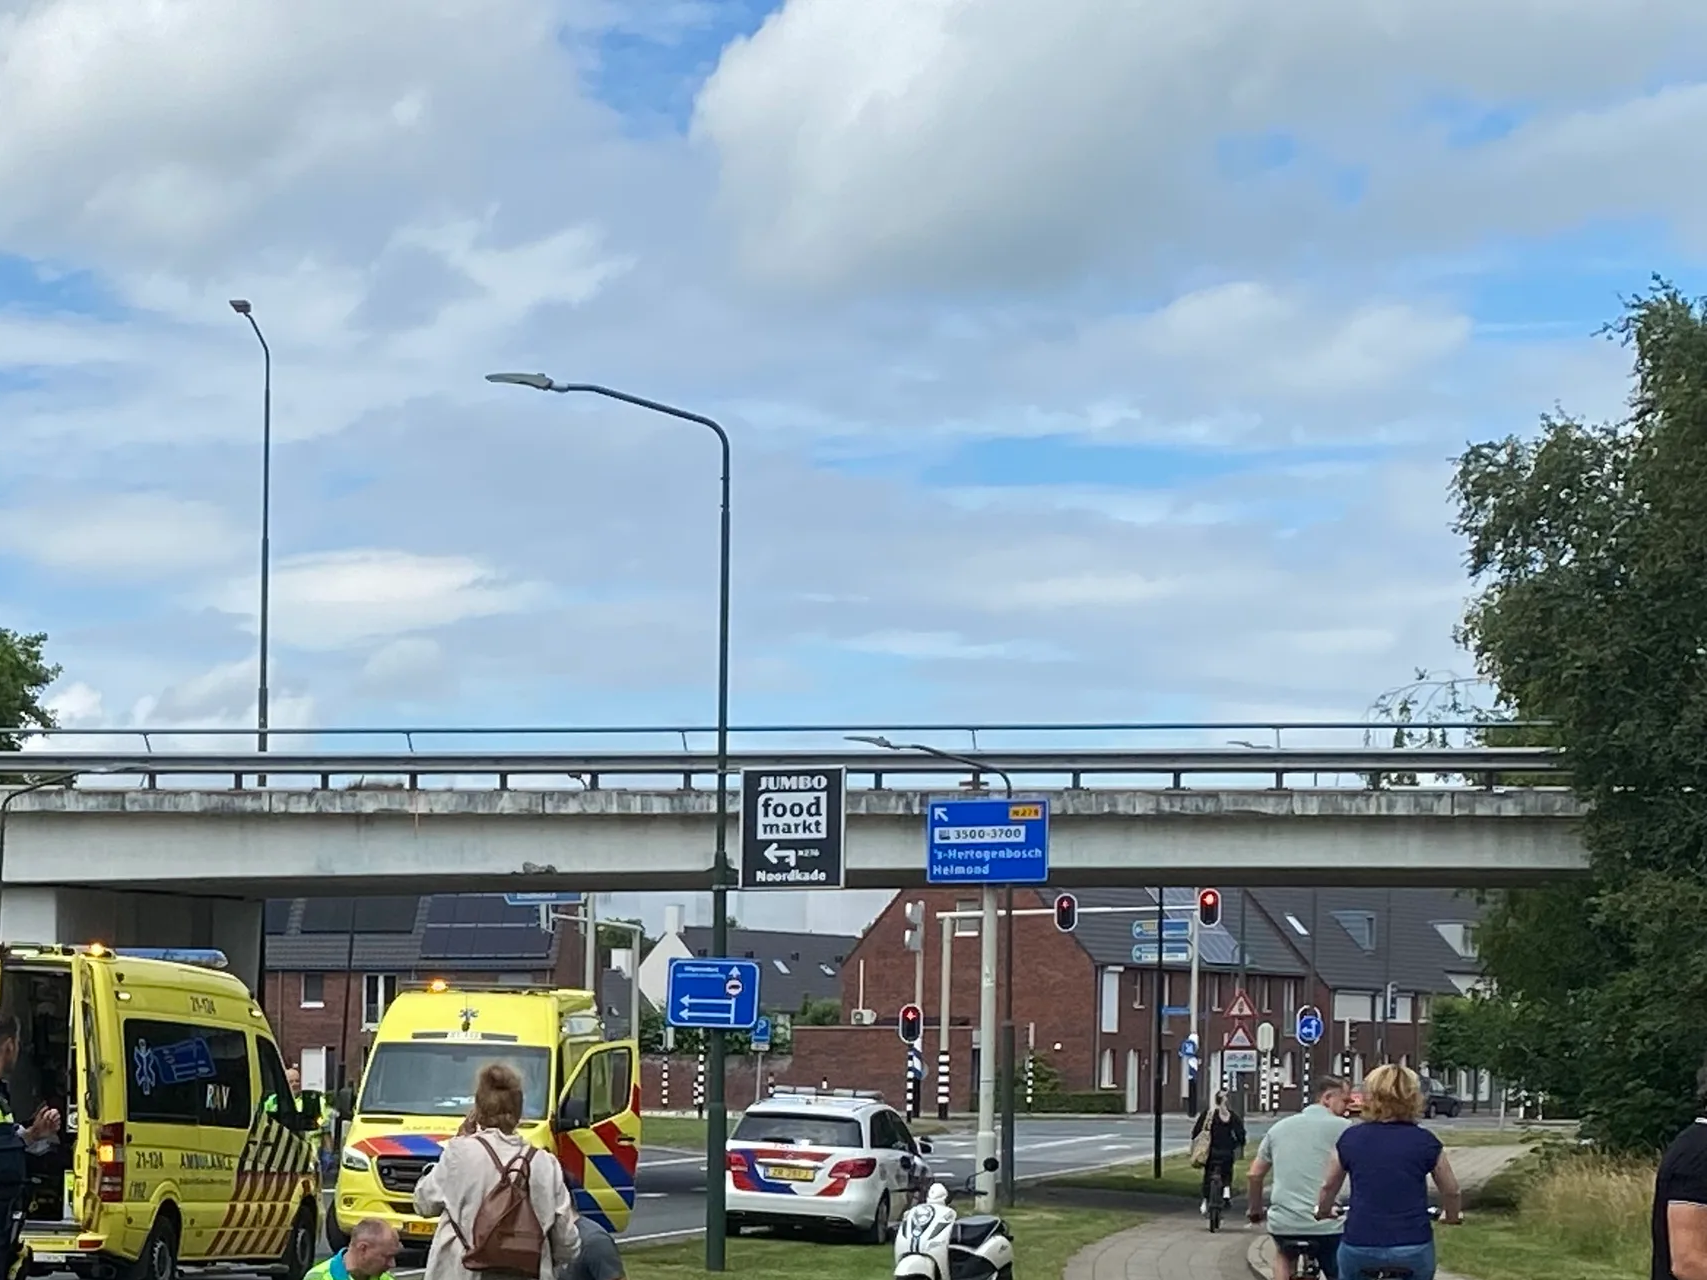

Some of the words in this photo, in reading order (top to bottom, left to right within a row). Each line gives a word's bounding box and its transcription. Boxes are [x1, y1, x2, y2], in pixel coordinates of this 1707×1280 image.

[758, 775, 828, 791] JUMBO
[762, 796, 823, 818] food
[762, 820, 822, 835] markt
[934, 848, 1043, 862] 's-Hertogenbosch
[756, 869, 827, 882] Noordkade
[932, 864, 990, 876] Helmond
[179, 1151, 234, 1171] AMBULANCE
